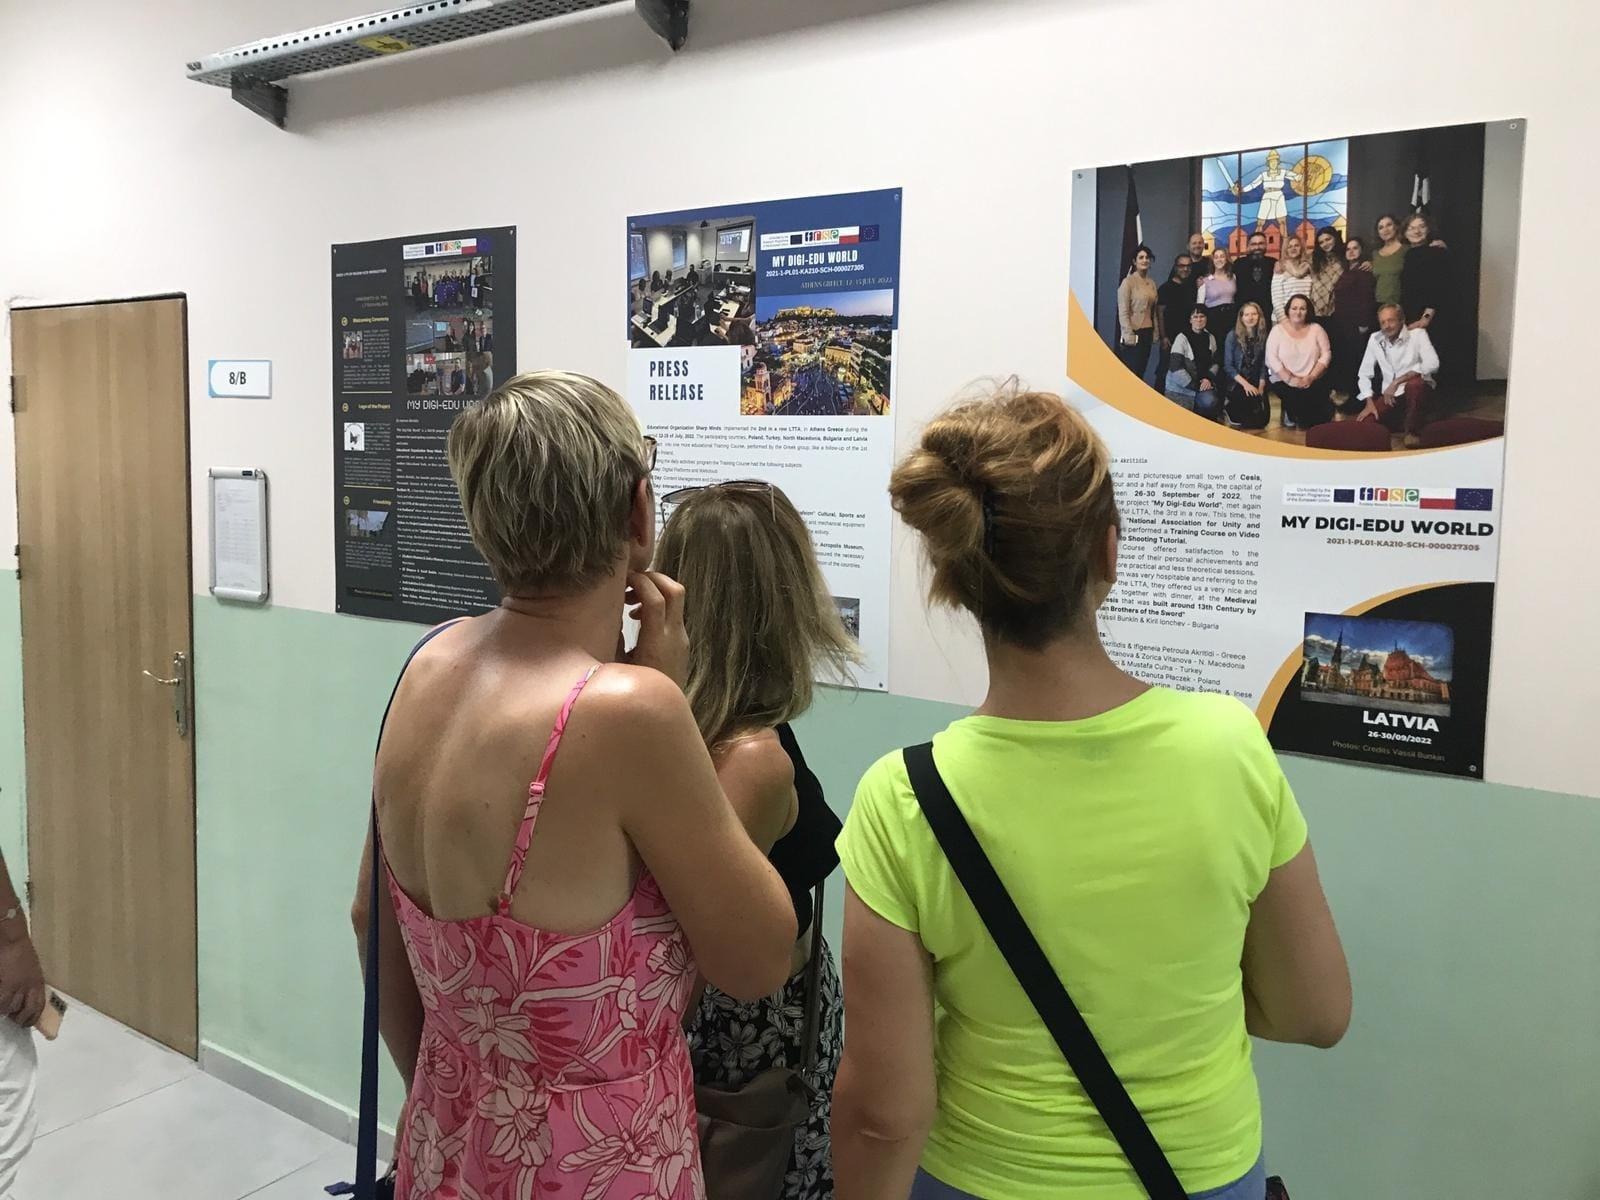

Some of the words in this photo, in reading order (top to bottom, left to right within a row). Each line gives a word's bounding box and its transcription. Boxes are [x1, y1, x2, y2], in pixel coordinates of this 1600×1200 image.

[772, 255, 784, 267] MY
[788, 252, 825, 266] DIGI-EDU
[828, 250, 858, 264] WORLD
[650, 360, 689, 377] PRESS
[229, 371, 247, 385] 8/B
[650, 384, 703, 400] RELEASE
[407, 400, 421, 409] MY
[423, 400, 460, 410] DIGI-EDU
[1162, 491, 1200, 499] September
[1359, 487, 1419, 502] frse
[1166, 500, 1196, 509] Digi-Edu
[1223, 521, 1241, 529] Unity
[1281, 516, 1310, 529] MY
[1315, 517, 1404, 533] DIGI-EDU
[1411, 520, 1494, 536] WORLD
[1170, 528, 1199, 537] Training
[1128, 535, 1158, 544] Shooting
[1327, 538, 1480, 551] 2021-1-PL01-KA210-SCH-000027305
[1185, 547, 1223, 556] satisfaction
[1165, 556, 1193, 564] personal
[1196, 557, 1242, 566] achievements
[1129, 562, 1157, 571] practical
[1186, 566, 1223, 574] theoretical
[1156, 573, 1190, 582] hospitable
[1206, 576, 1236, 586] referring
[1151, 582, 1166, 590] they
[1168, 582, 1192, 591] offered
[1121, 589, 1149, 598] together
[1224, 596, 1257, 605] Medieval
[1111, 605, 1139, 614] Brothers
[1215, 604, 1245, 614] Century
[1117, 615, 1139, 623] Bunkin
[1192, 621, 1219, 631] Bulgaria
[1142, 653, 1162, 661] Zorica
[1163, 655, 1192, 664] Vitanova
[1208, 660, 1245, 670] Macedonia
[1221, 651, 1246, 660] Greece
[1127, 660, 1153, 669] Mustafa
[1180, 666, 1202, 676] Turkey
[1141, 671, 1164, 680] Danuta
[1198, 677, 1220, 686] Poland
[1234, 690, 1252, 698] Inese
[1362, 710, 1439, 732] LATVIA
[1367, 731, 1432, 745] 26-30/09/2022
[1362, 744, 1390, 754] Credits
[1393, 748, 1415, 758] Vassil
[1417, 752, 1446, 761] Bunkin
